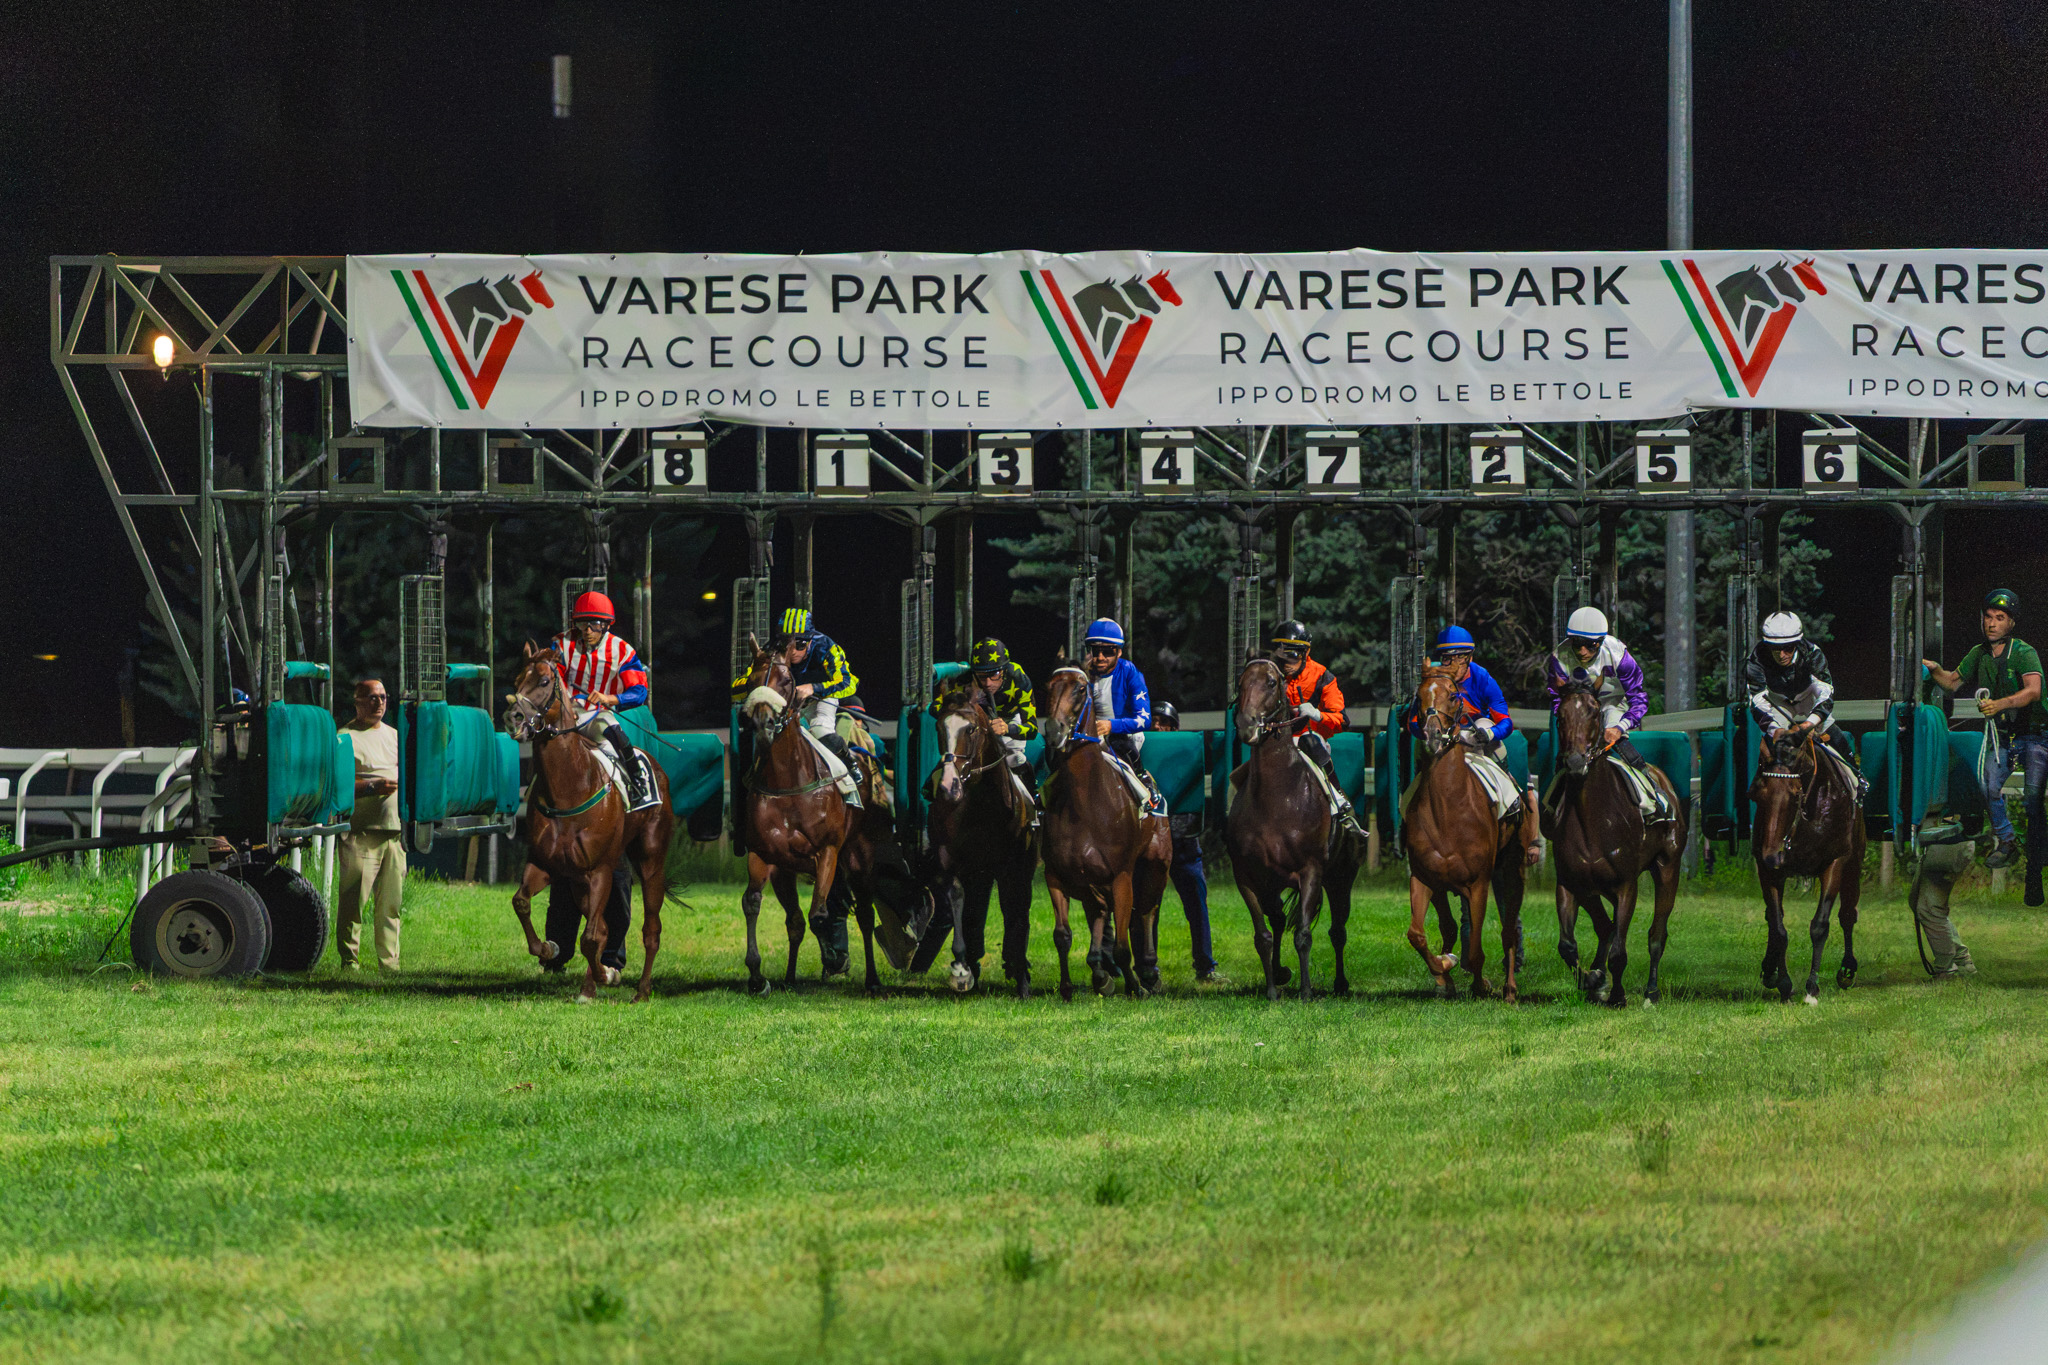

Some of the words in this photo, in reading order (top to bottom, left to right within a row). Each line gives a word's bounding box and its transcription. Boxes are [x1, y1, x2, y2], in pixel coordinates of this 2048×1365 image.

[577, 273, 808, 315] VARESE
[831, 274, 989, 314] PARK
[1213, 268, 1446, 310] VARESE
[1469, 265, 1630, 308] PARK
[582, 335, 988, 369] RACECOURSE
[1219, 327, 1629, 365] RACECOURSE
[580, 388, 777, 408] IPPODROMO
[797, 389, 829, 407] LE
[850, 389, 990, 408] BETTOLE
[1218, 384, 1417, 404] IPPODROMO
[1437, 384, 1470, 402] LE
[1490, 381, 1632, 401] BETTOLE
[1849, 378, 2048, 399] IPPODROMO
[664, 448, 693, 486] 8
[831, 449, 844, 487] 1
[990, 447, 1020, 486] 3
[1151, 447, 1181, 485] 4
[1317, 446, 1348, 484] 7
[1480, 445, 1512, 484] 2
[1647, 445, 1677, 482] 5
[1814, 444, 1844, 482] 6
